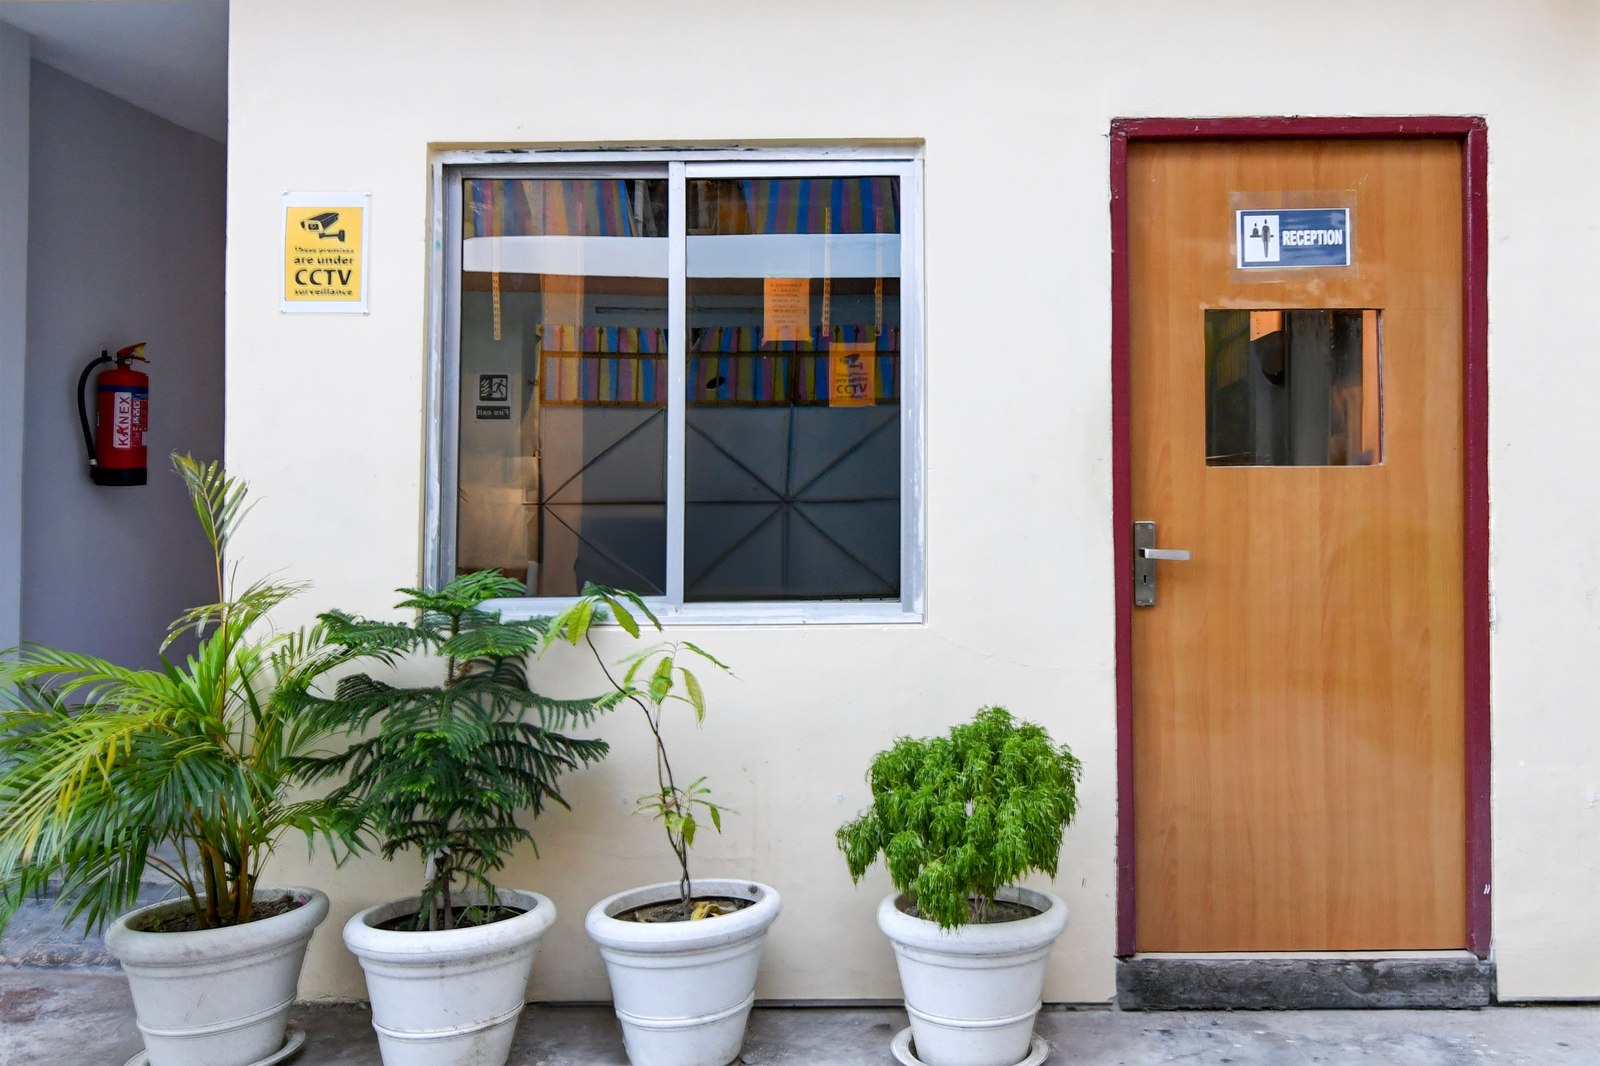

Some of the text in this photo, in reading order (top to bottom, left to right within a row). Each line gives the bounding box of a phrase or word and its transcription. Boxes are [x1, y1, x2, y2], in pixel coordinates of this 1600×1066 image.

[1282, 229, 1343, 246] RECEPTION
[317, 255, 353, 264] under
[295, 269, 352, 286] CCTV
[294, 287, 353, 295] surveillance
[837, 383, 867, 394] CCTV
